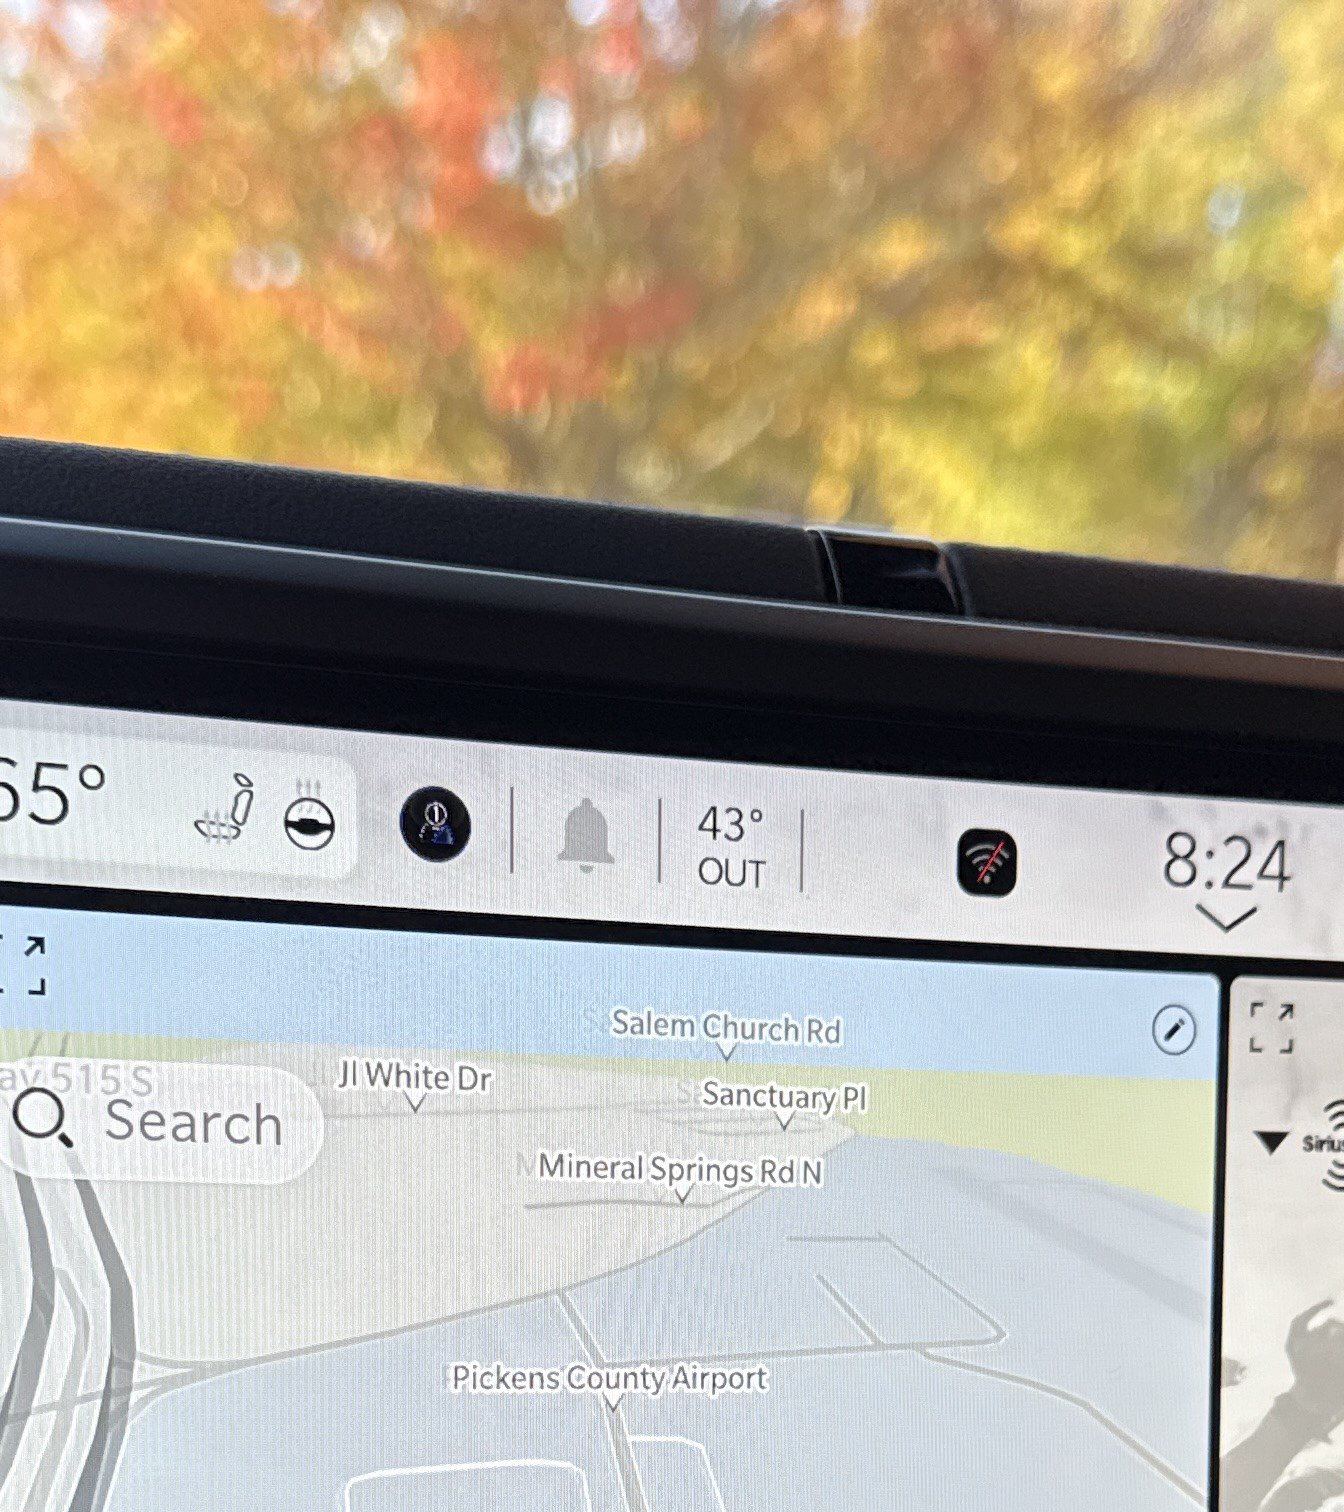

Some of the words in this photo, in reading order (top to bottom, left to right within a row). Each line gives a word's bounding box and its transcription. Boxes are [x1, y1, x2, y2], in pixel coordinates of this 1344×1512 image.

[698, 806, 764, 842] 43°
[698, 856, 766, 889] OUT
[1163, 831, 1293, 894] 8:24
[612, 1009, 695, 1038] Salem
[703, 1013, 799, 1043] Church
[807, 1018, 840, 1044] Rd
[52, 1062, 122, 1096] 515
[131, 1065, 154, 1098] S
[366, 1062, 450, 1090] White
[459, 1065, 492, 1091] Dr
[703, 1081, 837, 1115] Sanctuary
[105, 1097, 283, 1147] Search
[539, 1152, 643, 1181] Mineral
[651, 1156, 753, 1189] Springs
[761, 1159, 795, 1184] Rd
[802, 1161, 822, 1185] N
[454, 1363, 560, 1391] Pickens
[567, 1364, 665, 1397] County
[672, 1365, 768, 1395] Airport
